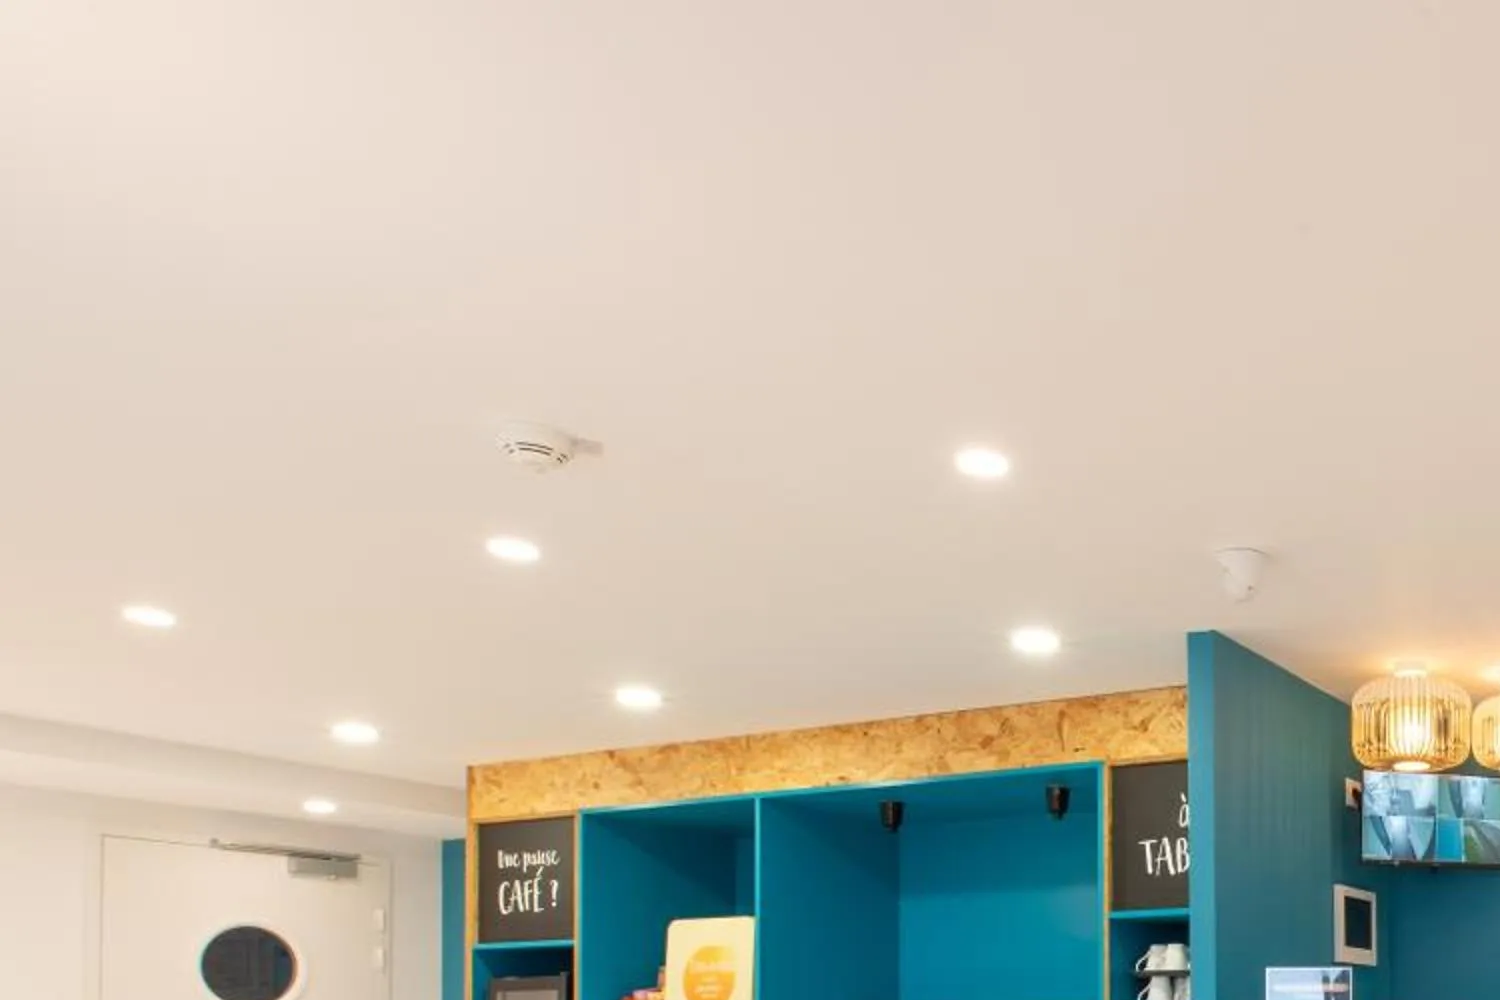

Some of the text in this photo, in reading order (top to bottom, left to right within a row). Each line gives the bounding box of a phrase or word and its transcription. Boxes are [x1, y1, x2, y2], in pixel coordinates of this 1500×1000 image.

[522, 848, 562, 874] pause
[1137, 836, 1191, 876] TAB
[498, 865, 560, 916] CAFÉ ?
